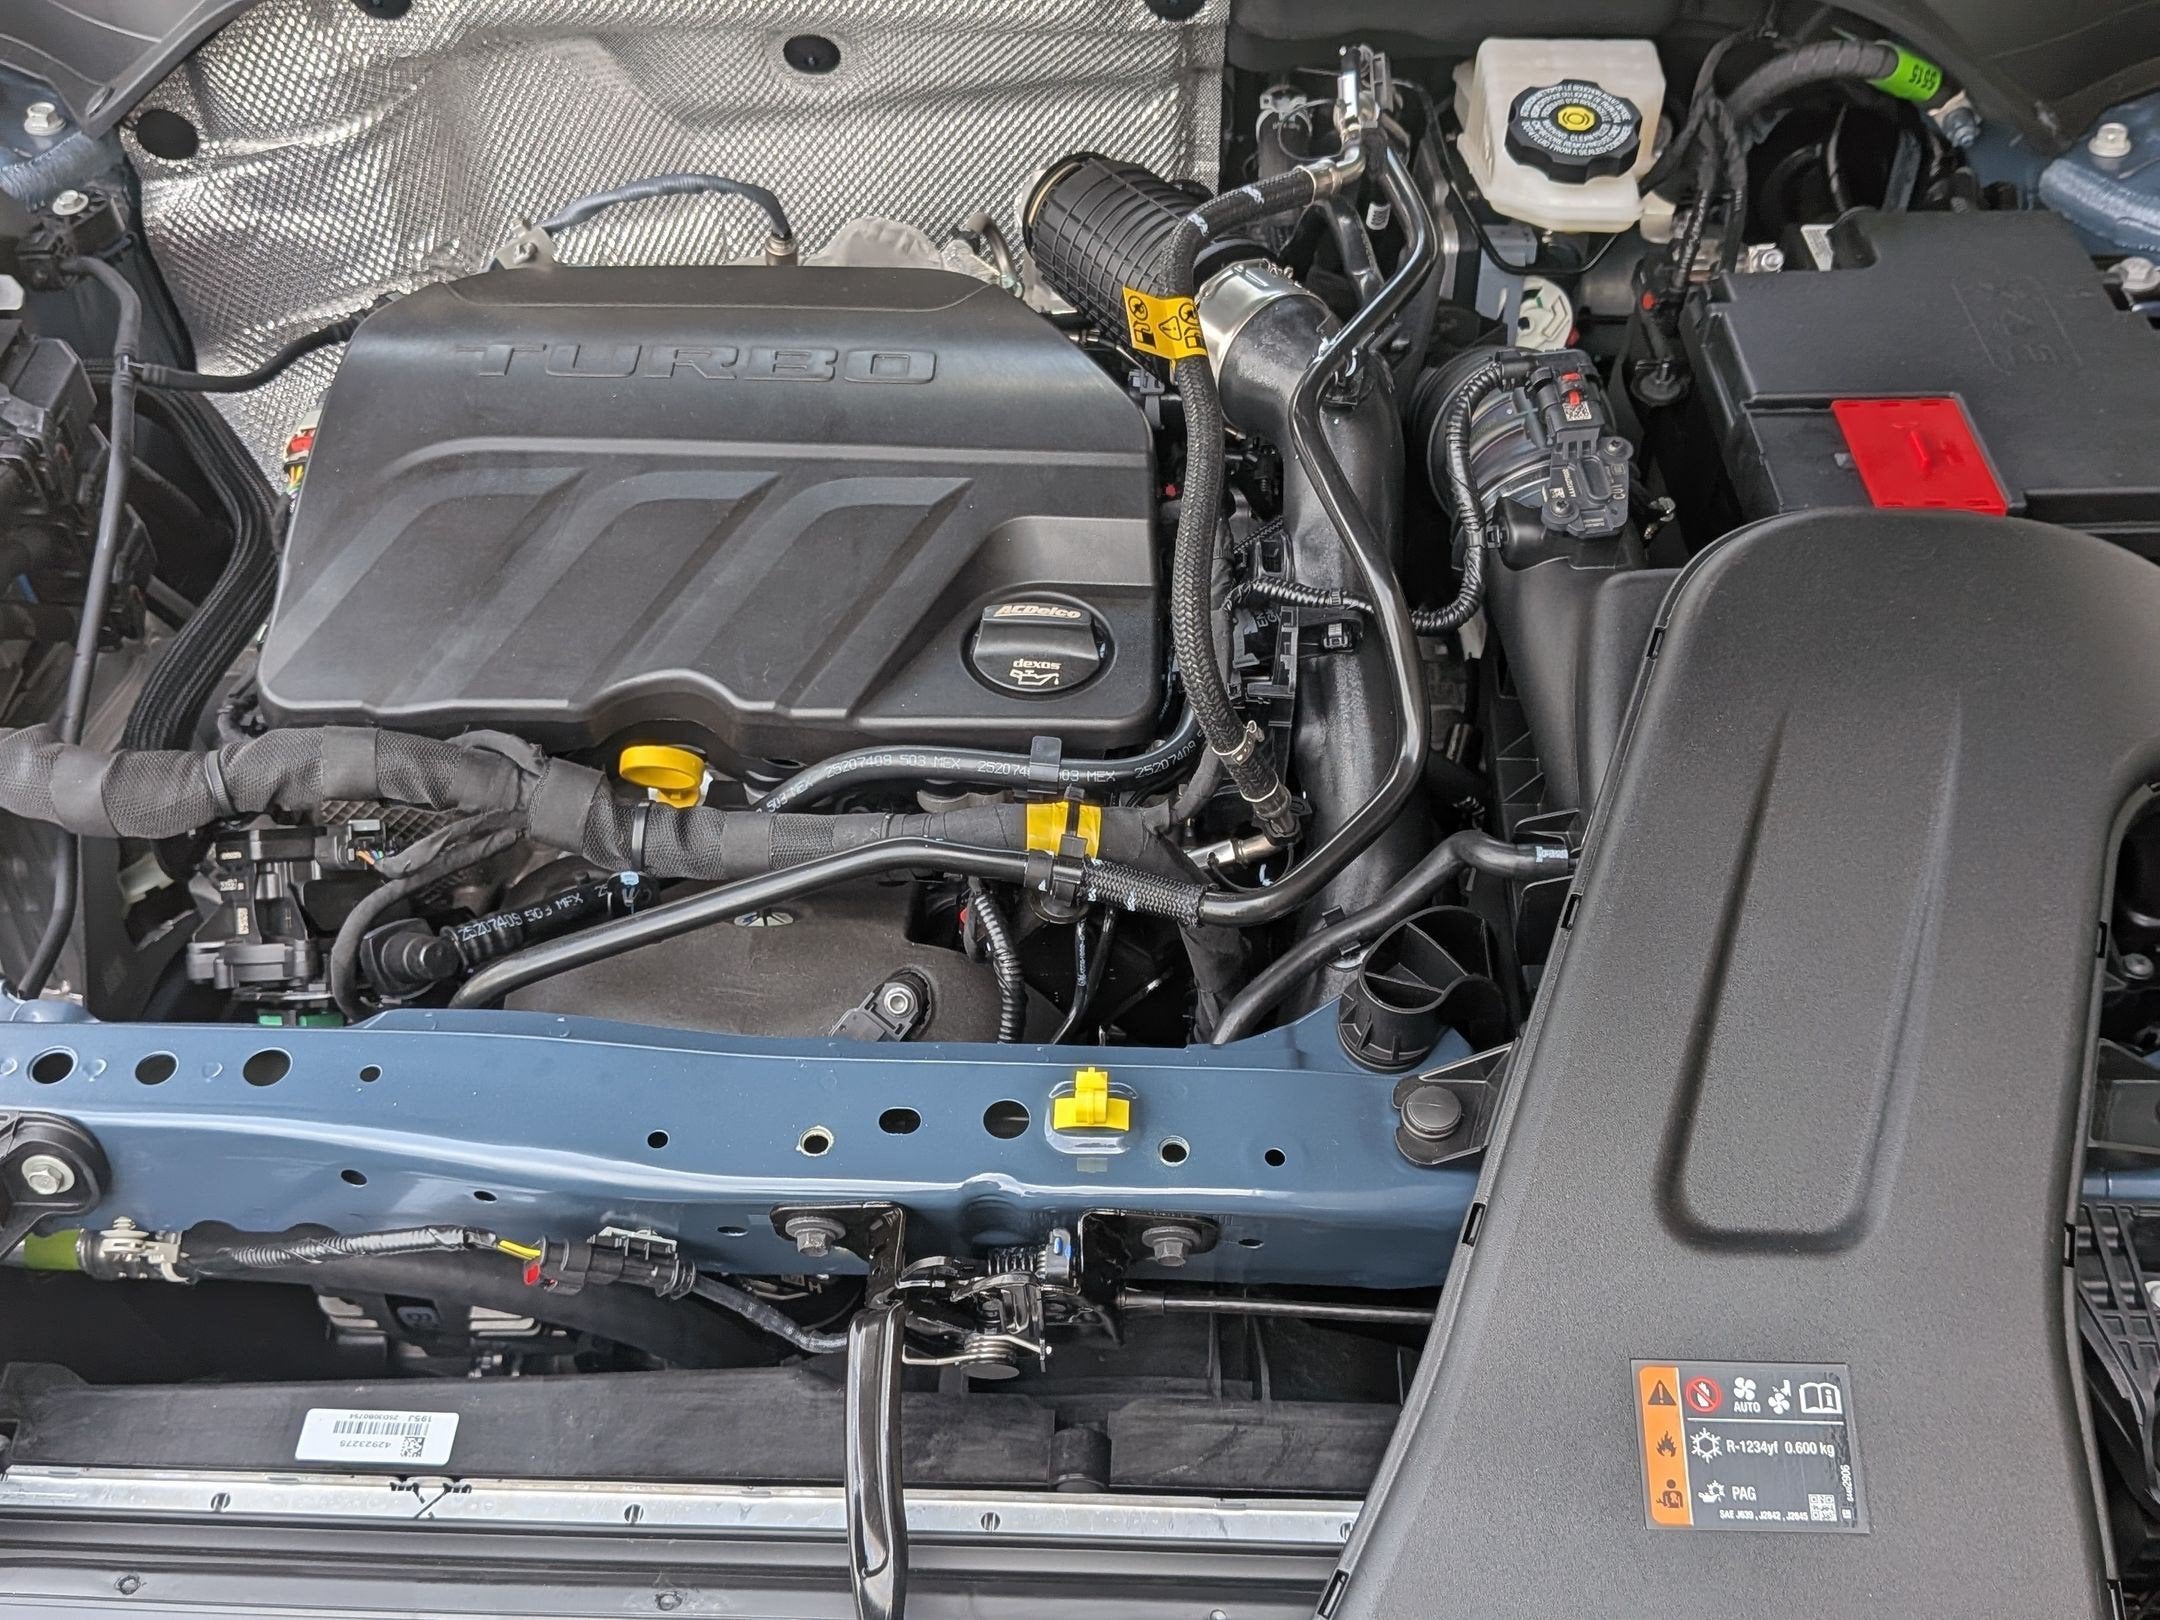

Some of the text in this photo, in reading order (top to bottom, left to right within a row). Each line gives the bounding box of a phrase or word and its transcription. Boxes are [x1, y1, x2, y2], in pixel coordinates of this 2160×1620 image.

[1549, 143, 1571, 154] FROM
[455, 343, 937, 385] TURBO
[993, 604, 1081, 619] ACDelco
[1013, 658, 1061, 670] dexos
[933, 755, 961, 770] MEX
[976, 760, 1031, 777] 252074
[1058, 769, 1080, 782] 03
[1086, 769, 1116, 783] MEX
[1733, 1401, 1761, 1413] AUTO
[1726, 1440, 1835, 1458] R-1234yf 0.600 kg
[1731, 1486, 1757, 1501] PAG
[1719, 1509, 1735, 1520] SAE
